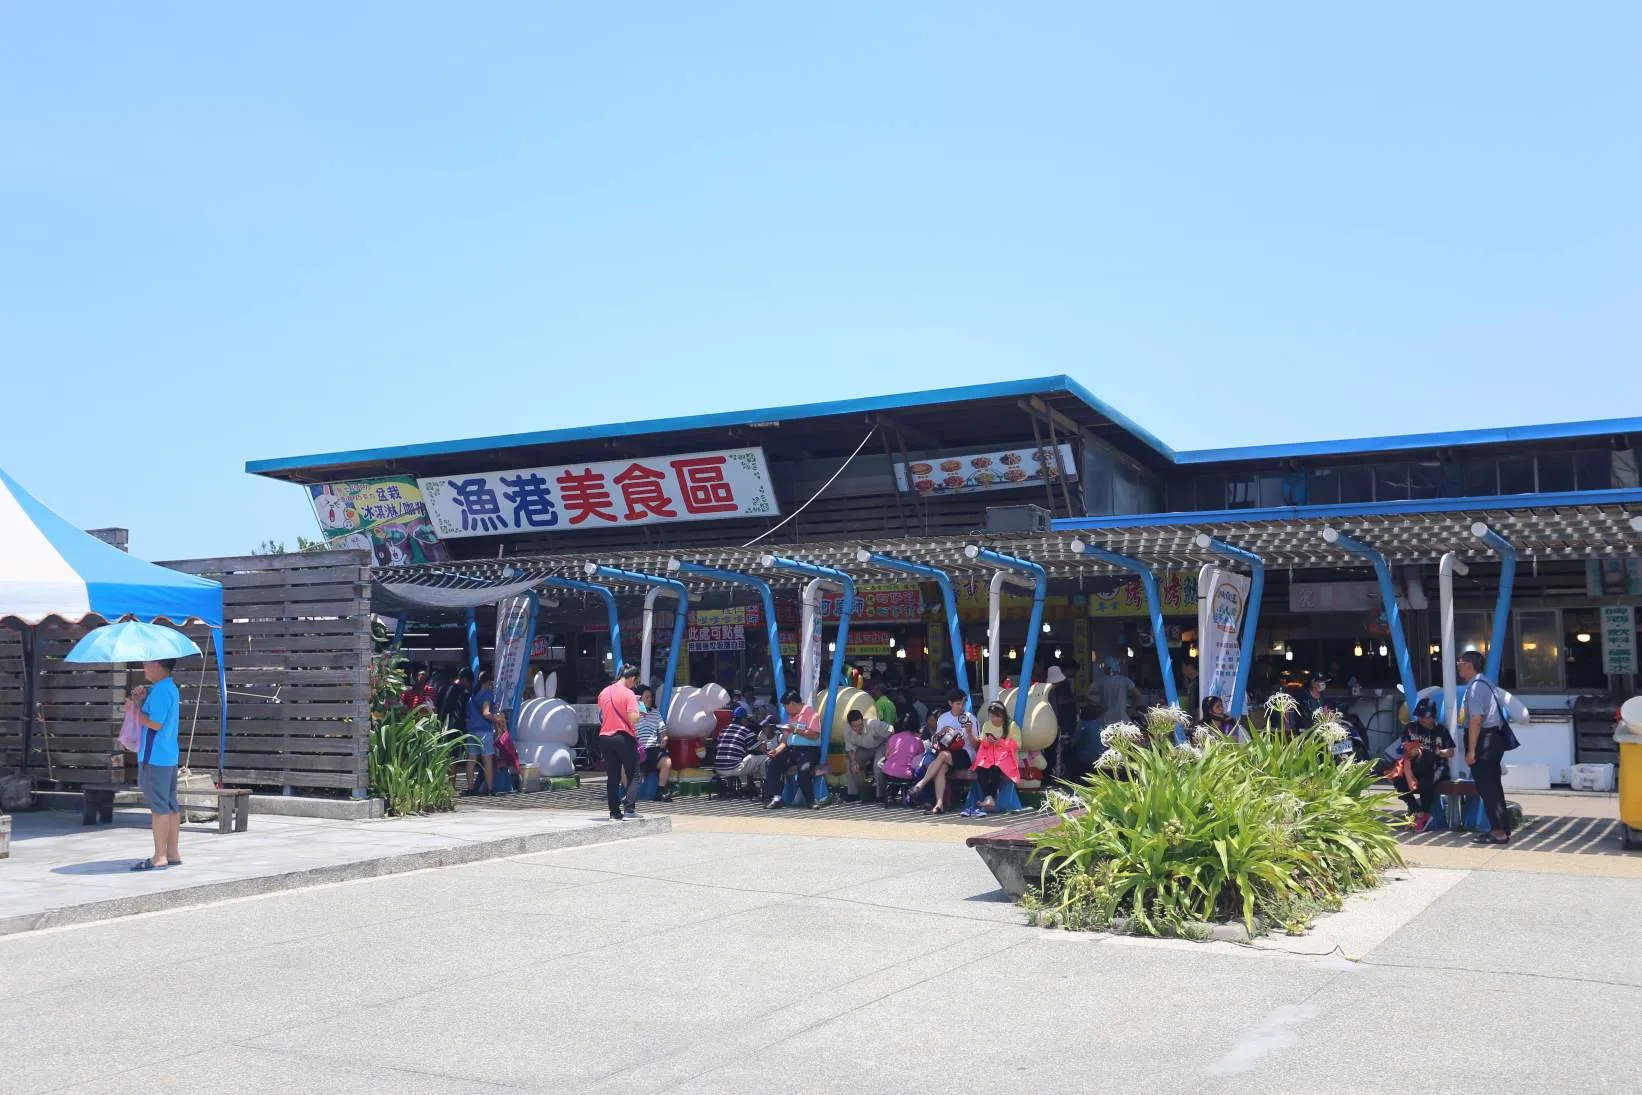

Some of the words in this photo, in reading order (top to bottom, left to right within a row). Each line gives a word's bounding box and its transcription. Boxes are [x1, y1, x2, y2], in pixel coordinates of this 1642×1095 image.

[376, 485, 402, 509] 盆栽
[447, 456, 739, 532] 漁港美食區
